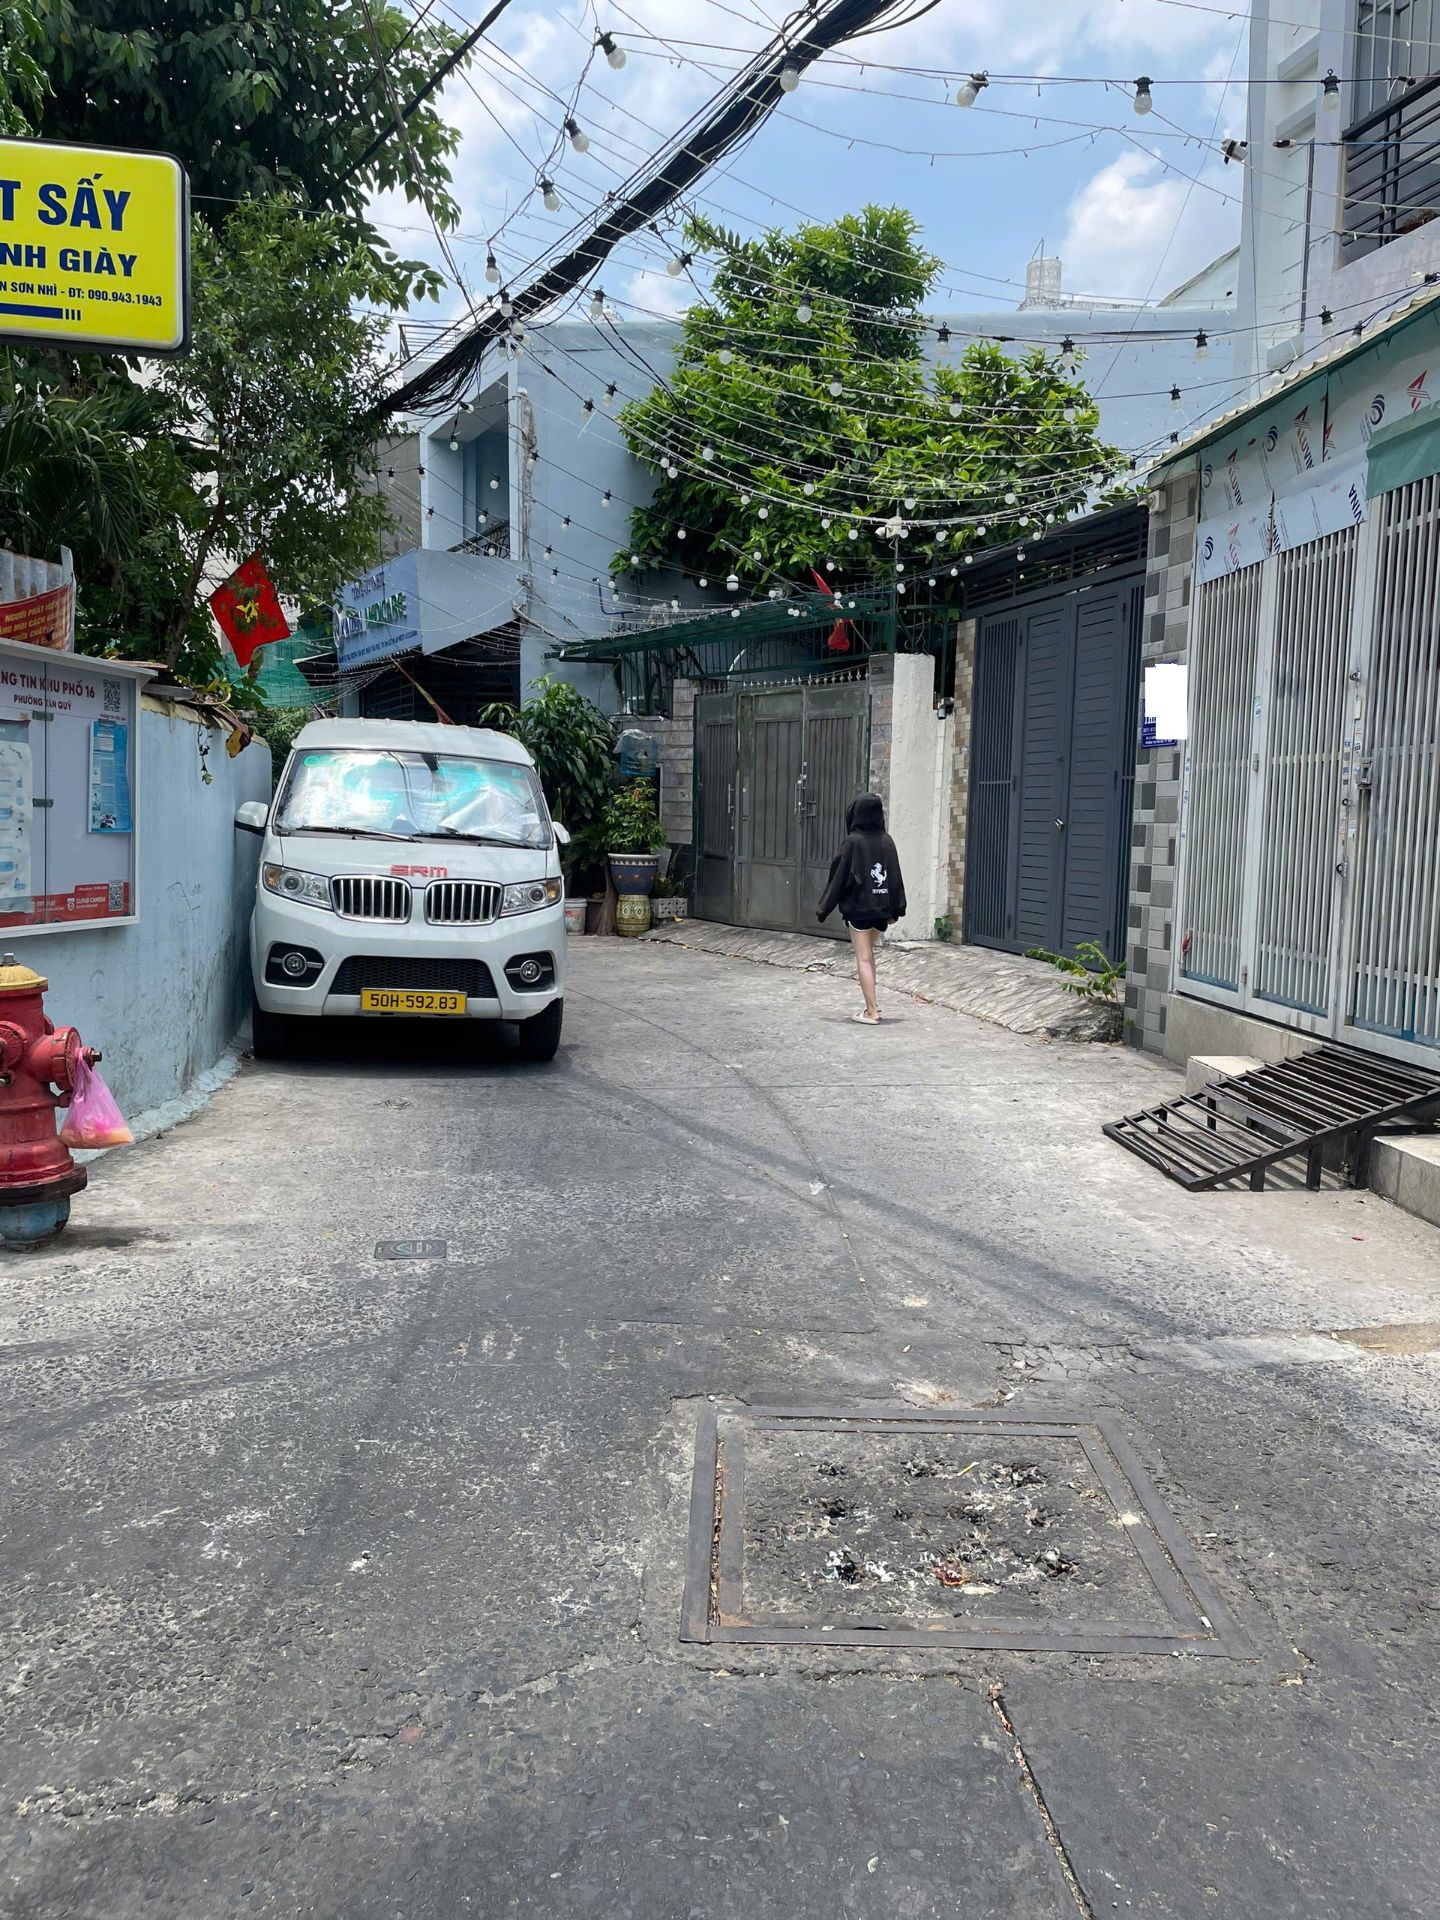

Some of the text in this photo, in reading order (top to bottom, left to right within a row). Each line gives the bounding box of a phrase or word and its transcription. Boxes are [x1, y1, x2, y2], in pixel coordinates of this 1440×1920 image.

[37, 173, 131, 231] SẤY
[59, 247, 137, 277] GIÀY
[11, 282, 34, 294] SƠN
[68, 287, 85, 299] ĐT:
[88, 289, 162, 306] 090.943.1943
[20, 674, 37, 690] TIN
[40, 677, 60, 693] KHU
[62, 680, 83, 697] PHỐ
[85, 686, 95, 699] 16
[14, 694, 43, 707] PHƯỜNG
[58, 700, 72, 710] QUÝ
[370, 993, 457, 1010] 50H-592.83
